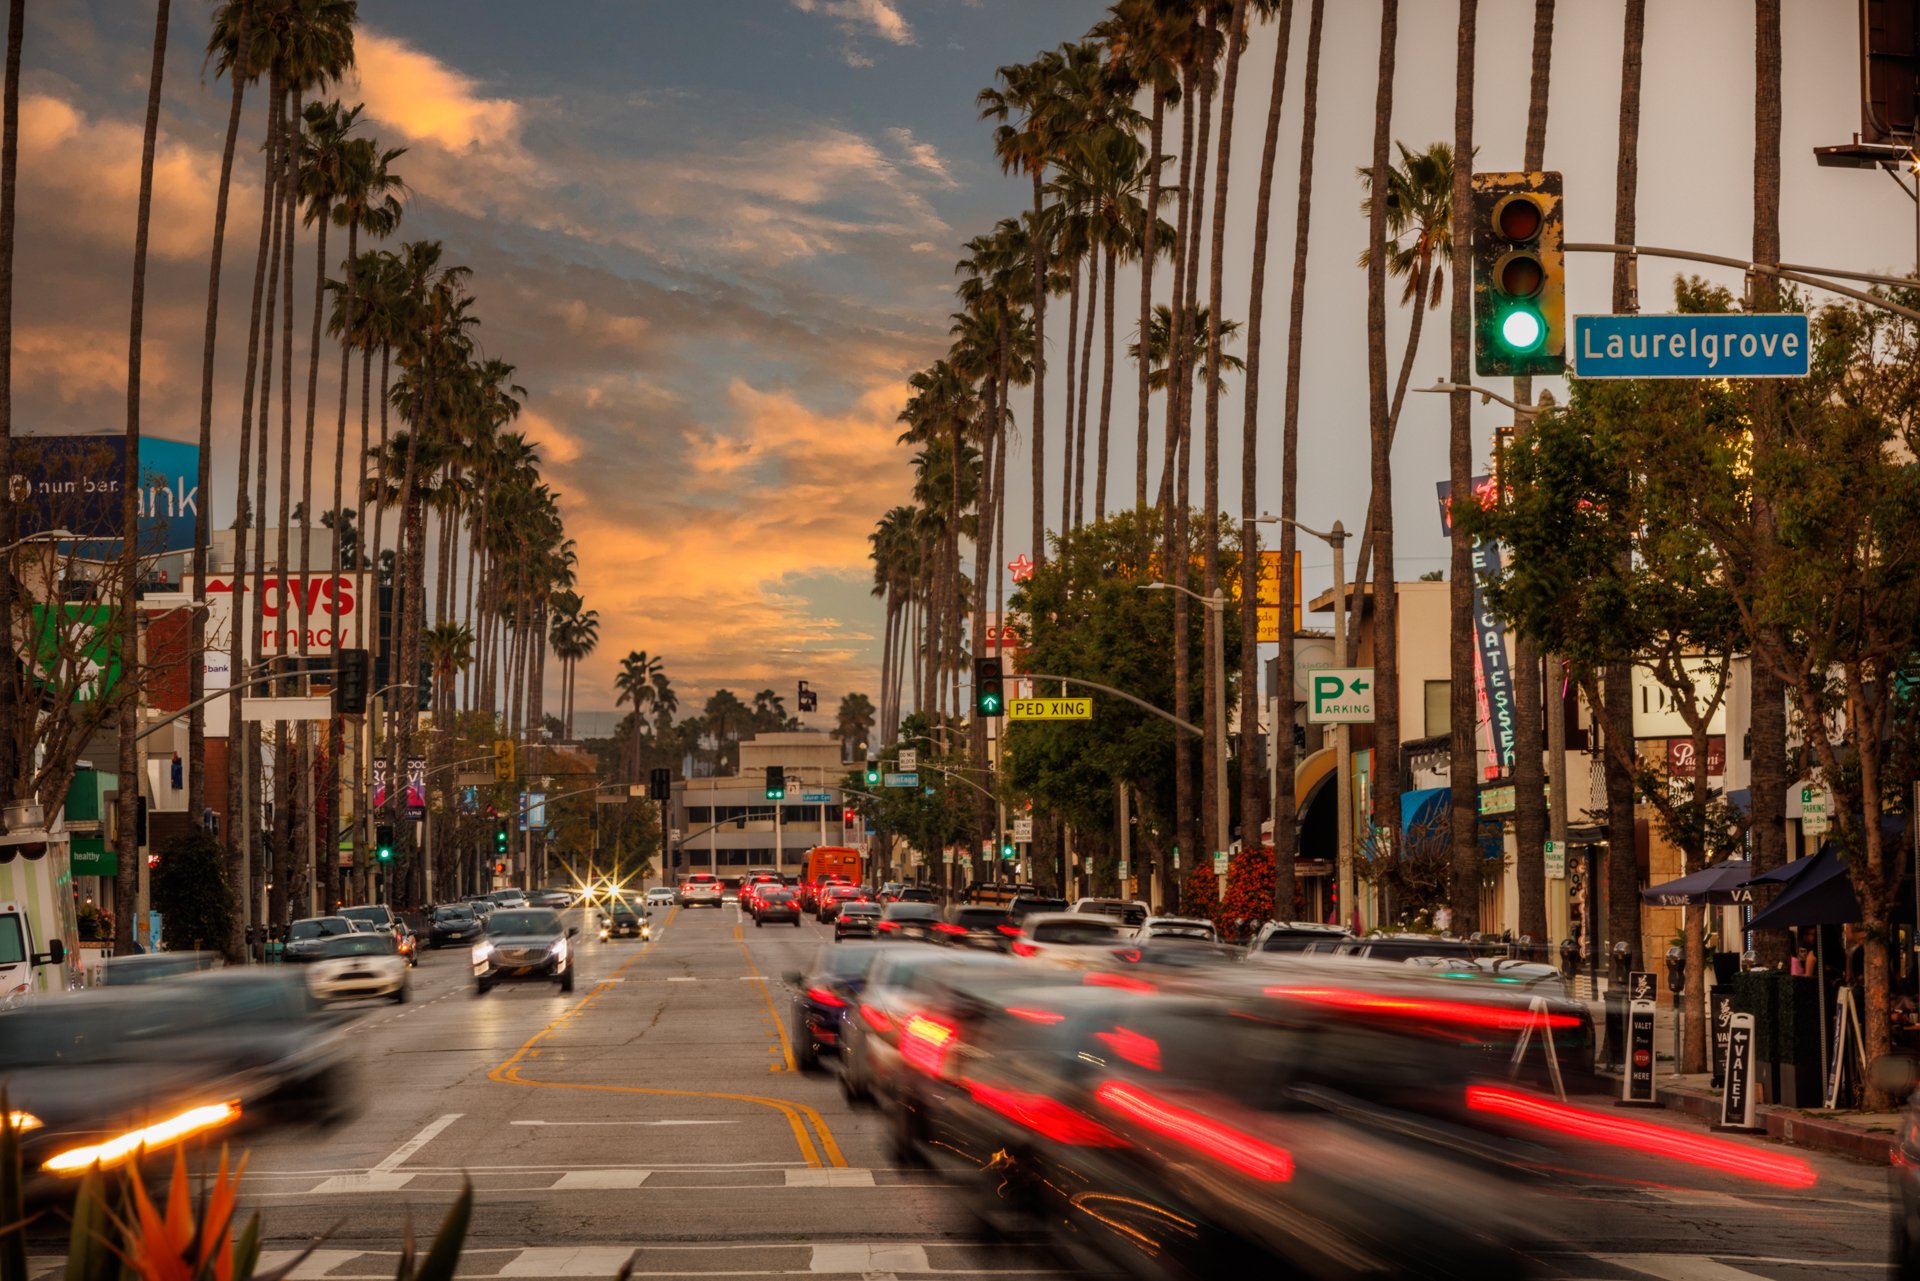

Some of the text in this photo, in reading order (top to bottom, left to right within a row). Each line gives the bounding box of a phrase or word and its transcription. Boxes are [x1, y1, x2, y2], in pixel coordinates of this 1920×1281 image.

[1584, 327, 1799, 369] Laurelgrove
[207, 664, 229, 673] bank
[1016, 702, 1085, 716] PED XING
[1803, 790, 1809, 801] 2
[1802, 804, 1825, 812] PARKING
[73, 851, 100, 862] healthy
[1634, 1022, 1652, 1030] VALET
[1633, 1072, 1650, 1080] HERE
[1732, 1045, 1745, 1108] VALET
